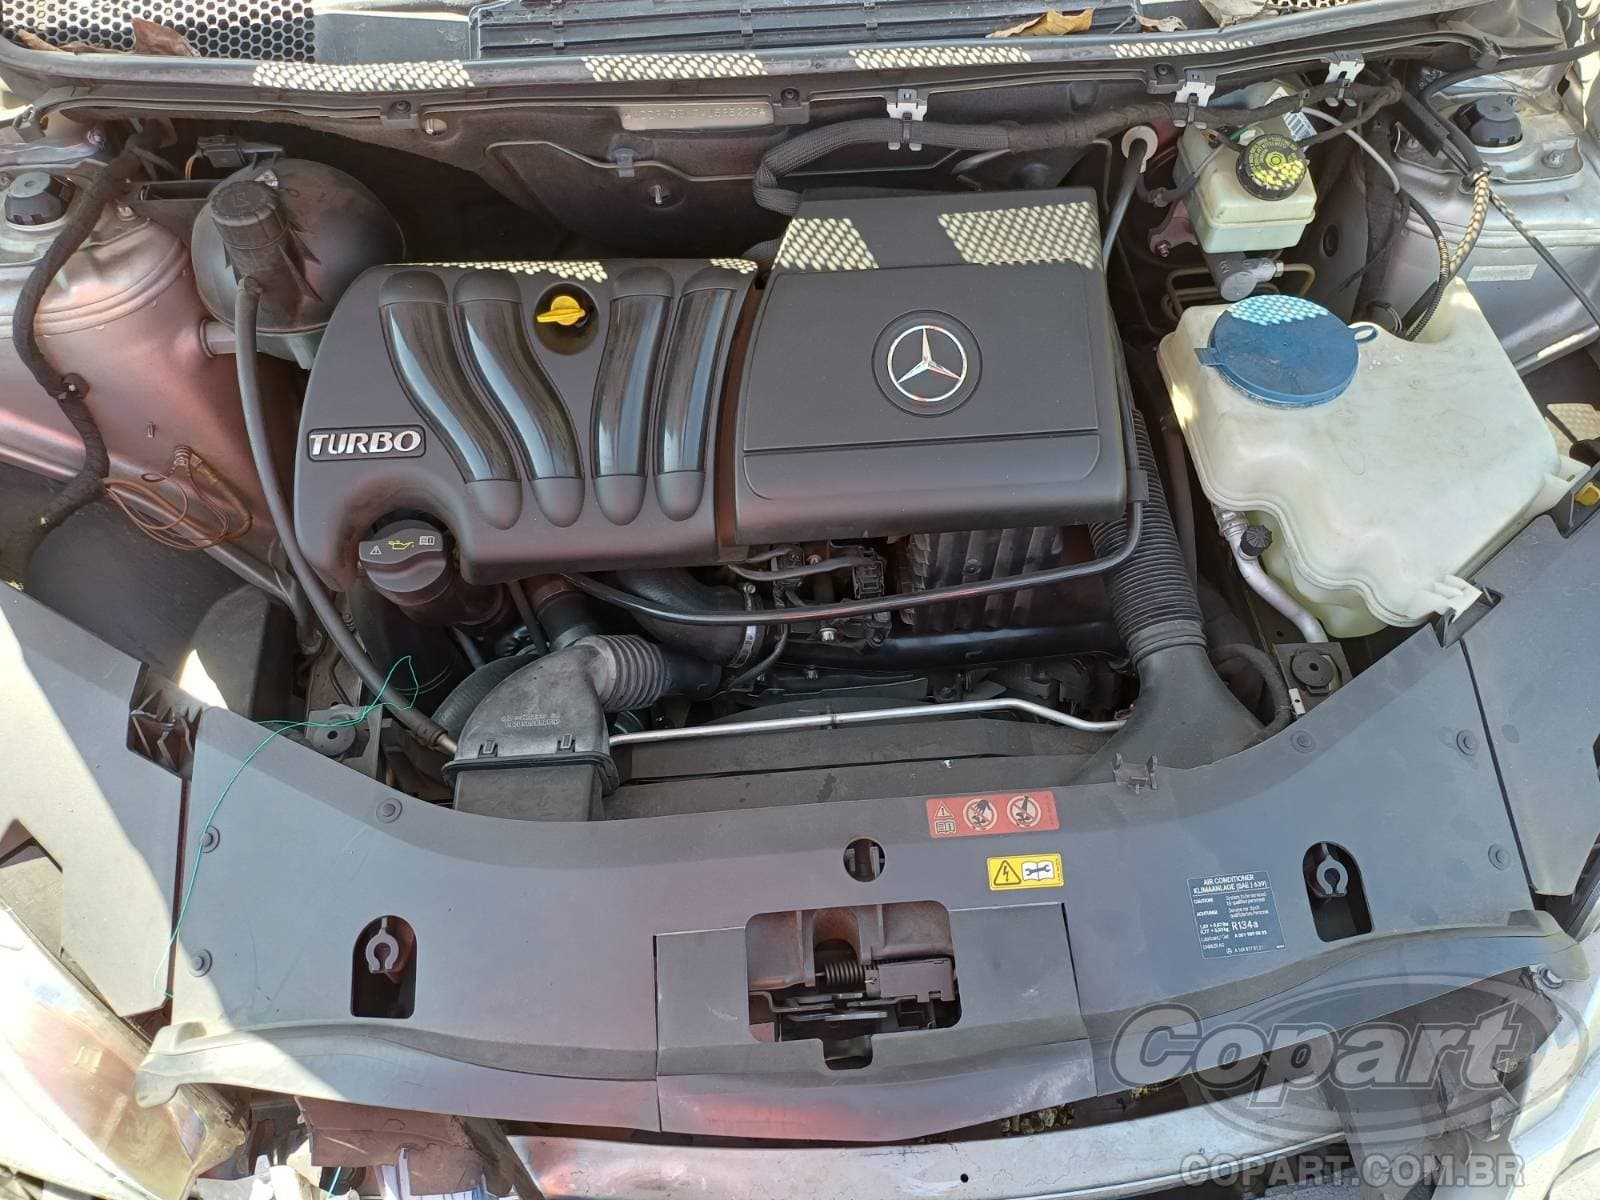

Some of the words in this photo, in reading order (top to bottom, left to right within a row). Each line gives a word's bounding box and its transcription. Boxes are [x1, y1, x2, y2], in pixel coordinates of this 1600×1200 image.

[310, 430, 421, 456] TURBO
[1203, 878, 1214, 886] AIR
[1214, 874, 1255, 885] CONDITIONER
[1231, 920, 1259, 931] R134a
